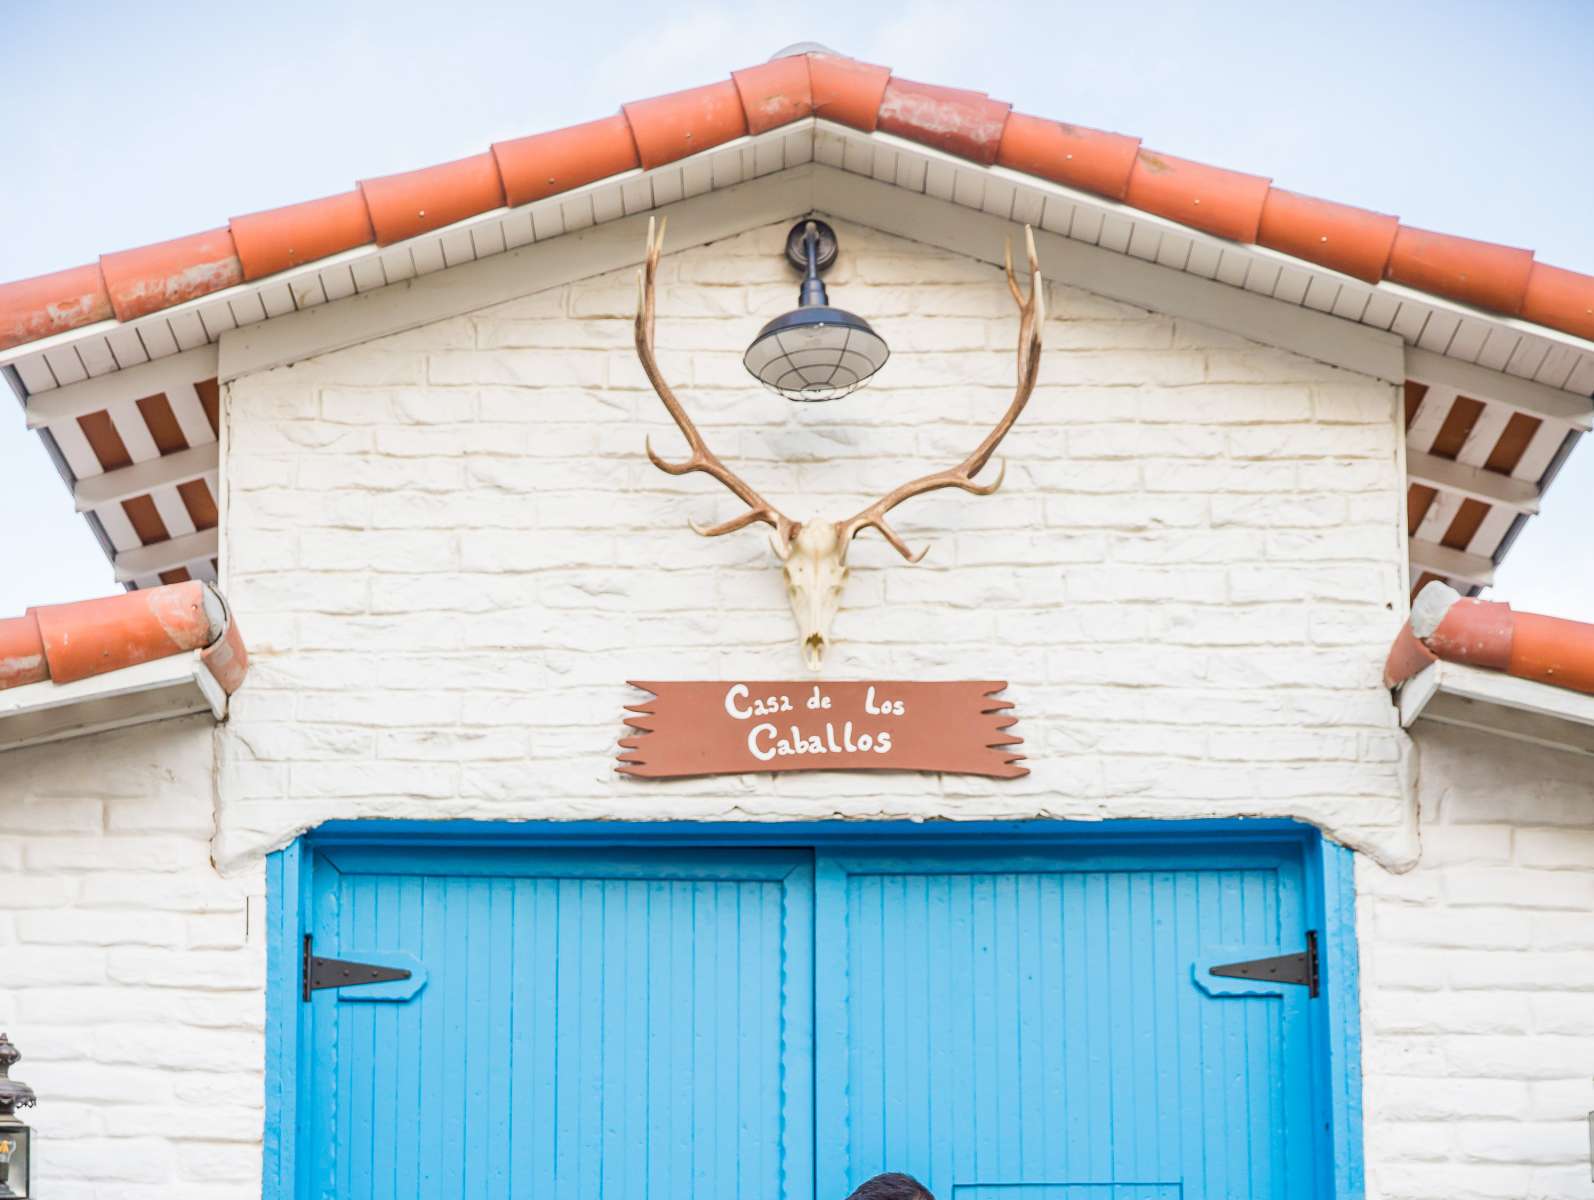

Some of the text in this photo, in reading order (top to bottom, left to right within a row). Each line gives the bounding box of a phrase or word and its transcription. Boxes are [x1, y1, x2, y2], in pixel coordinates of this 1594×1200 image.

[724, 683, 906, 720] Casa de Los
[747, 722, 893, 761] Caballos
